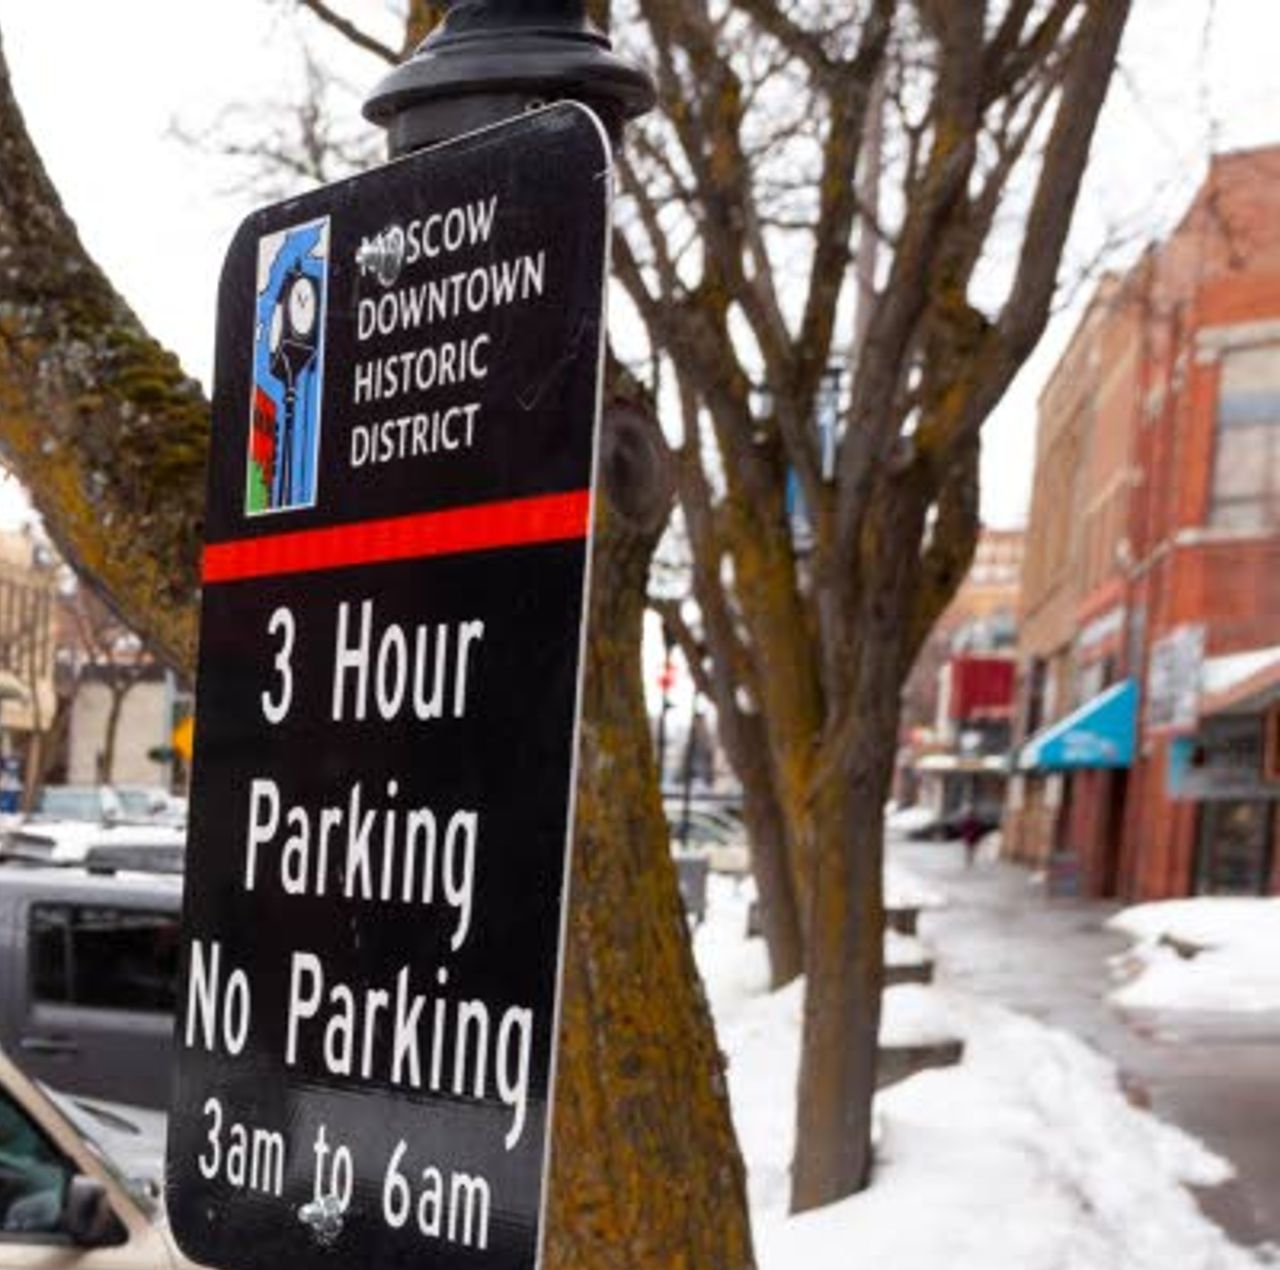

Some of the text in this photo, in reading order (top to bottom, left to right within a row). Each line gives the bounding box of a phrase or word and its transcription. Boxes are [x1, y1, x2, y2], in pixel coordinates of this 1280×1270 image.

[358, 250, 545, 341] DOWNTOWN
[355, 334, 489, 404] HISTORIC
[351, 403, 481, 467] DISTRICT
[261, 600, 485, 724] 3 Hour
[245, 779, 478, 951] Parking
[185, 940, 534, 1151] No Parking
[199, 1098, 491, 1250] 3am to 6am
